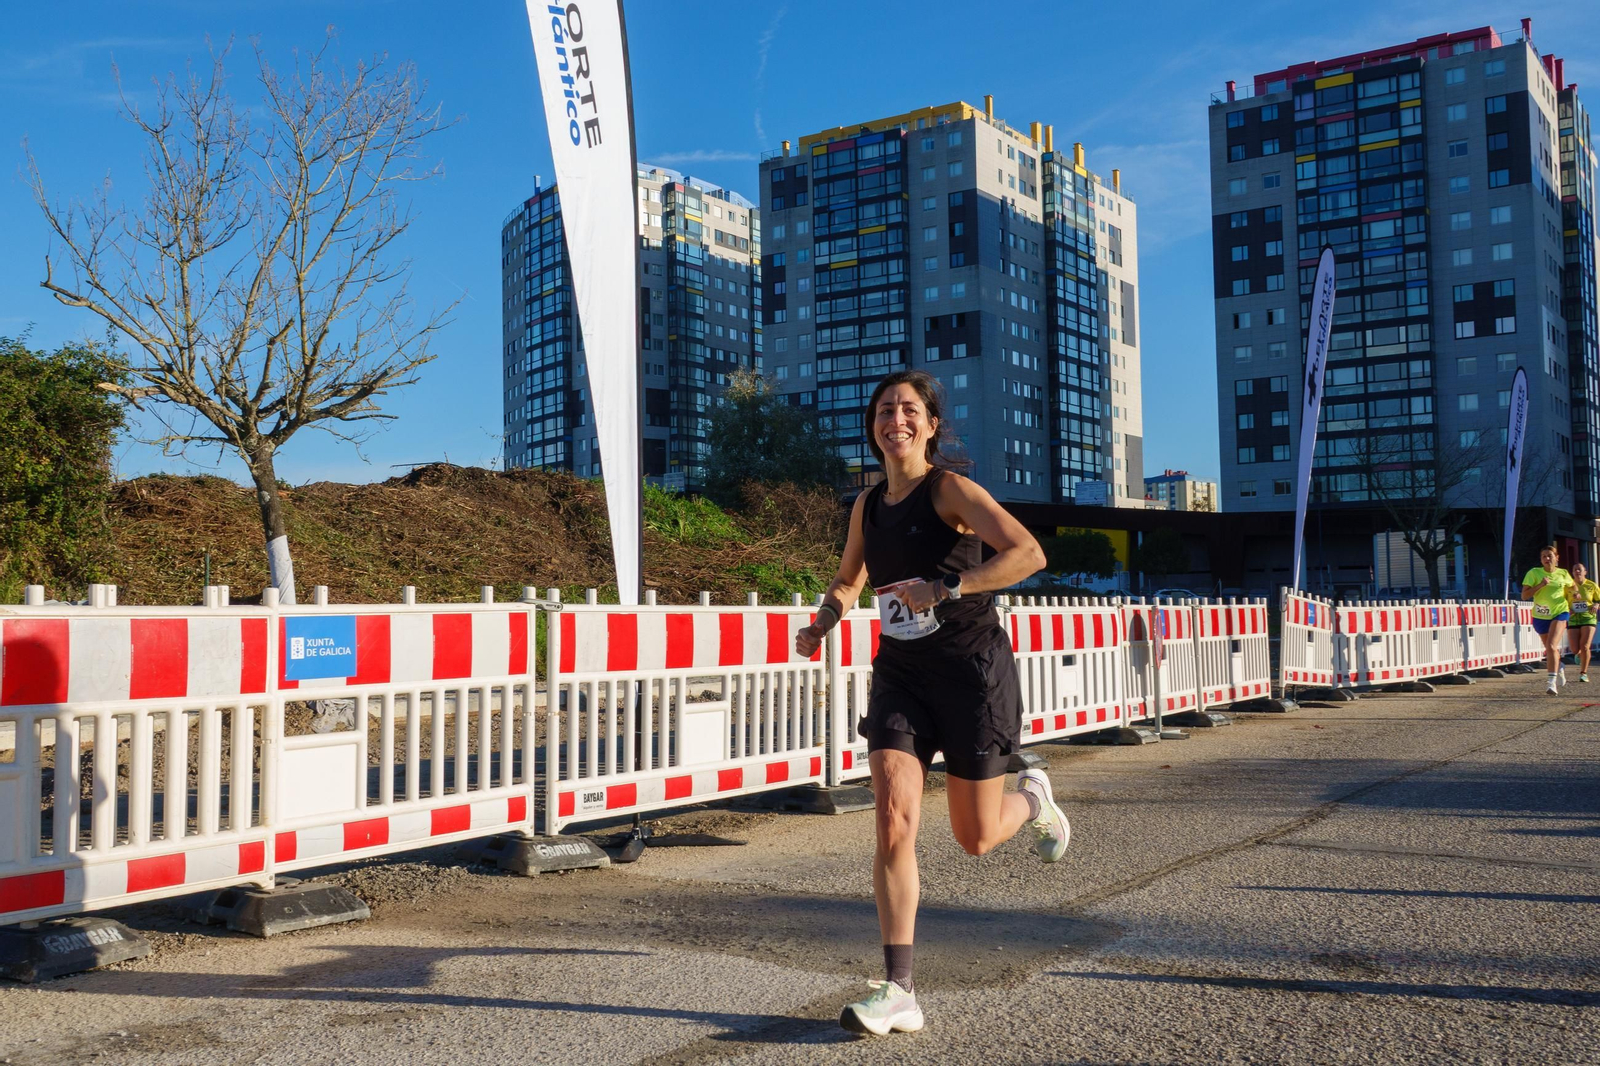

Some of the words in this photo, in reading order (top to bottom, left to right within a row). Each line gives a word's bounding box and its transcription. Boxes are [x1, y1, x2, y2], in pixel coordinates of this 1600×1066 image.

[547, 0, 580, 146] lántico
[565, 3, 602, 149] ORTE
[306, 638, 335, 647] XUNTA
[306, 648, 317, 657] DE
[319, 647, 352, 656] GALICIA
[583, 791, 604, 803] BAYGAR
[546, 842, 591, 858] BAYGAR
[60, 926, 124, 953] BAYGAR
